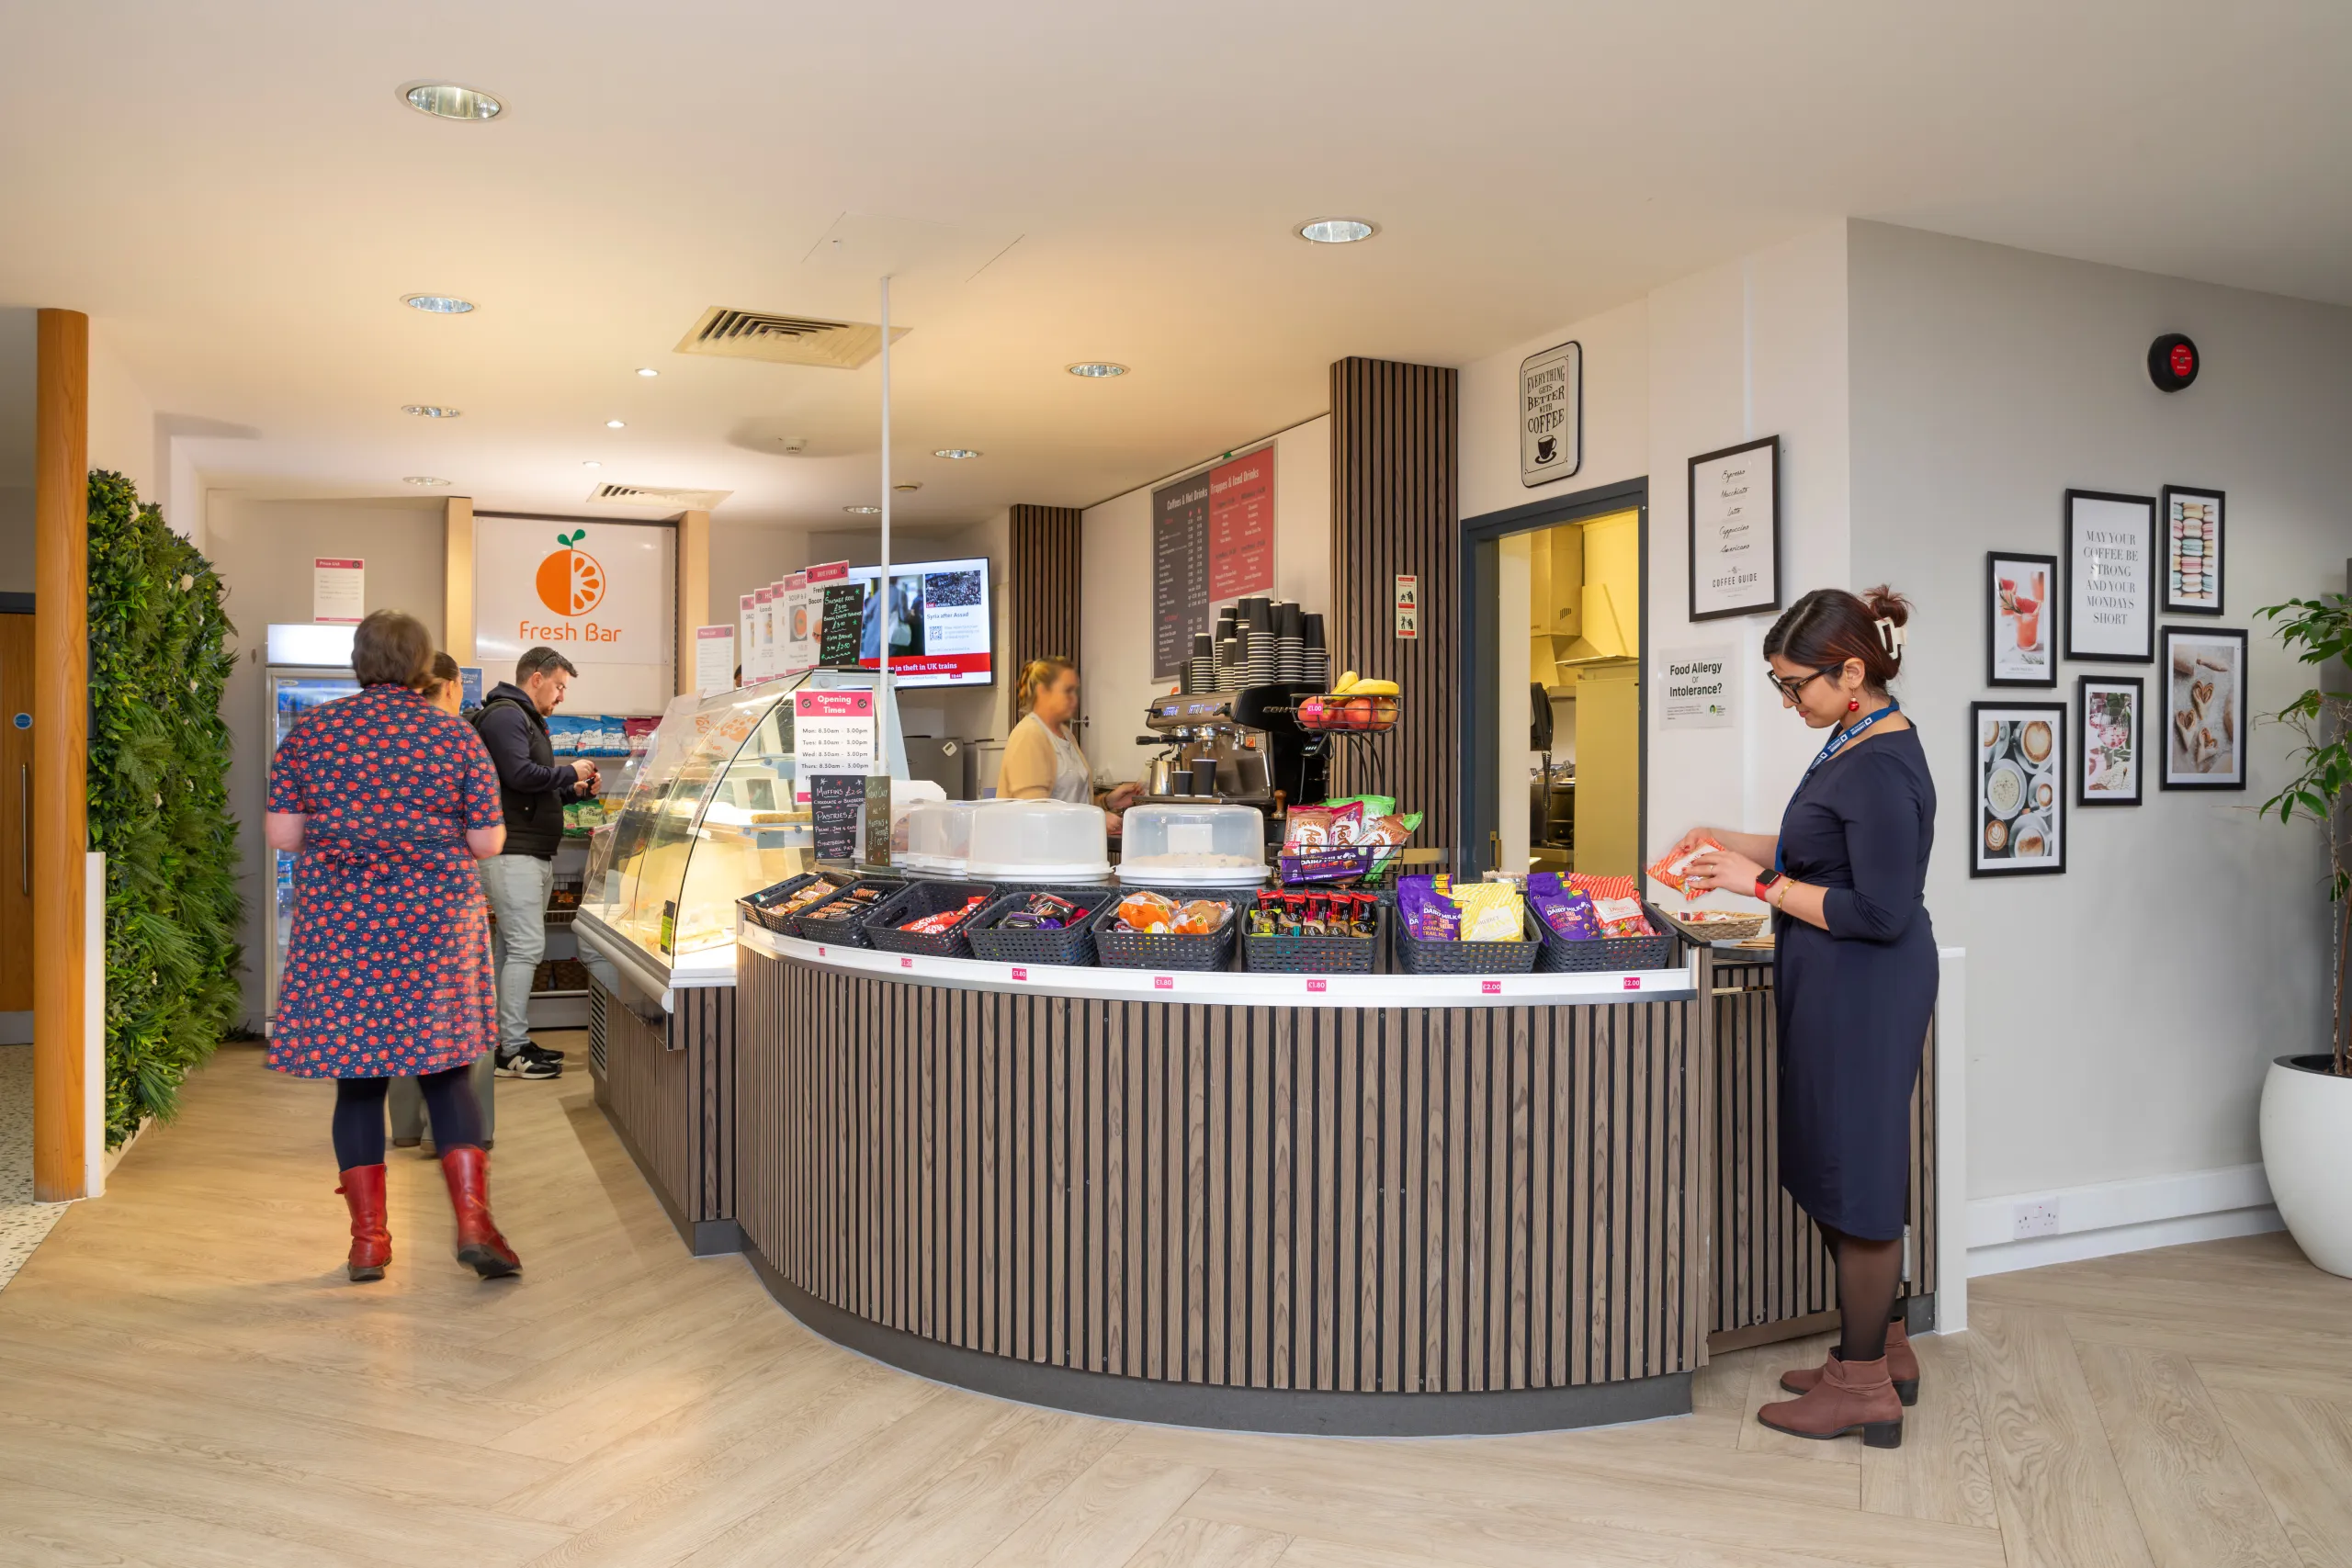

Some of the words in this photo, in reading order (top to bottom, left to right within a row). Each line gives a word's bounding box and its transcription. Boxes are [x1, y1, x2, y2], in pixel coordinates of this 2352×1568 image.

[1527, 366, 1565, 394] EVERYTHING
[1538, 384, 1553, 395] GETS
[1527, 385, 1565, 412] BETTER
[1539, 403, 1553, 413] WITH
[1527, 408, 1564, 434] COFFEE
[1244, 468, 1259, 481] Drinks
[1194, 487, 1207, 501] Drinks
[1727, 507, 1742, 516] Latte
[1719, 525, 1749, 539] Cappuccino
[2086, 530, 2107, 542] MAY
[2109, 533, 2136, 546] YOUR
[1720, 545, 1749, 553] Americano
[2084, 547, 2123, 560] COFFEE
[2126, 550, 2138, 561] BE
[2090, 563, 2132, 577] STRONG
[1713, 577, 1736, 588] COFFEE
[1738, 573, 1758, 584] GUIDE
[2086, 580, 2107, 592] AND
[2109, 581, 2135, 593] YOUR
[2087, 595, 2134, 609] MONDAYS
[2093, 613, 2128, 625] SHORT
[520, 621, 577, 640] Fresh
[585, 623, 621, 642] Bar
[1670, 663, 1690, 675] Food
[1691, 662, 1722, 674] Allergy
[1670, 682, 1722, 697] Intolerance?
[818, 695, 852, 705] Opening
[817, 786, 843, 796] MUFFINS
[816, 811, 847, 820] PASTRIES
[1423, 908, 1442, 917] DAIRY
[1547, 908, 1566, 916] DAIRY
